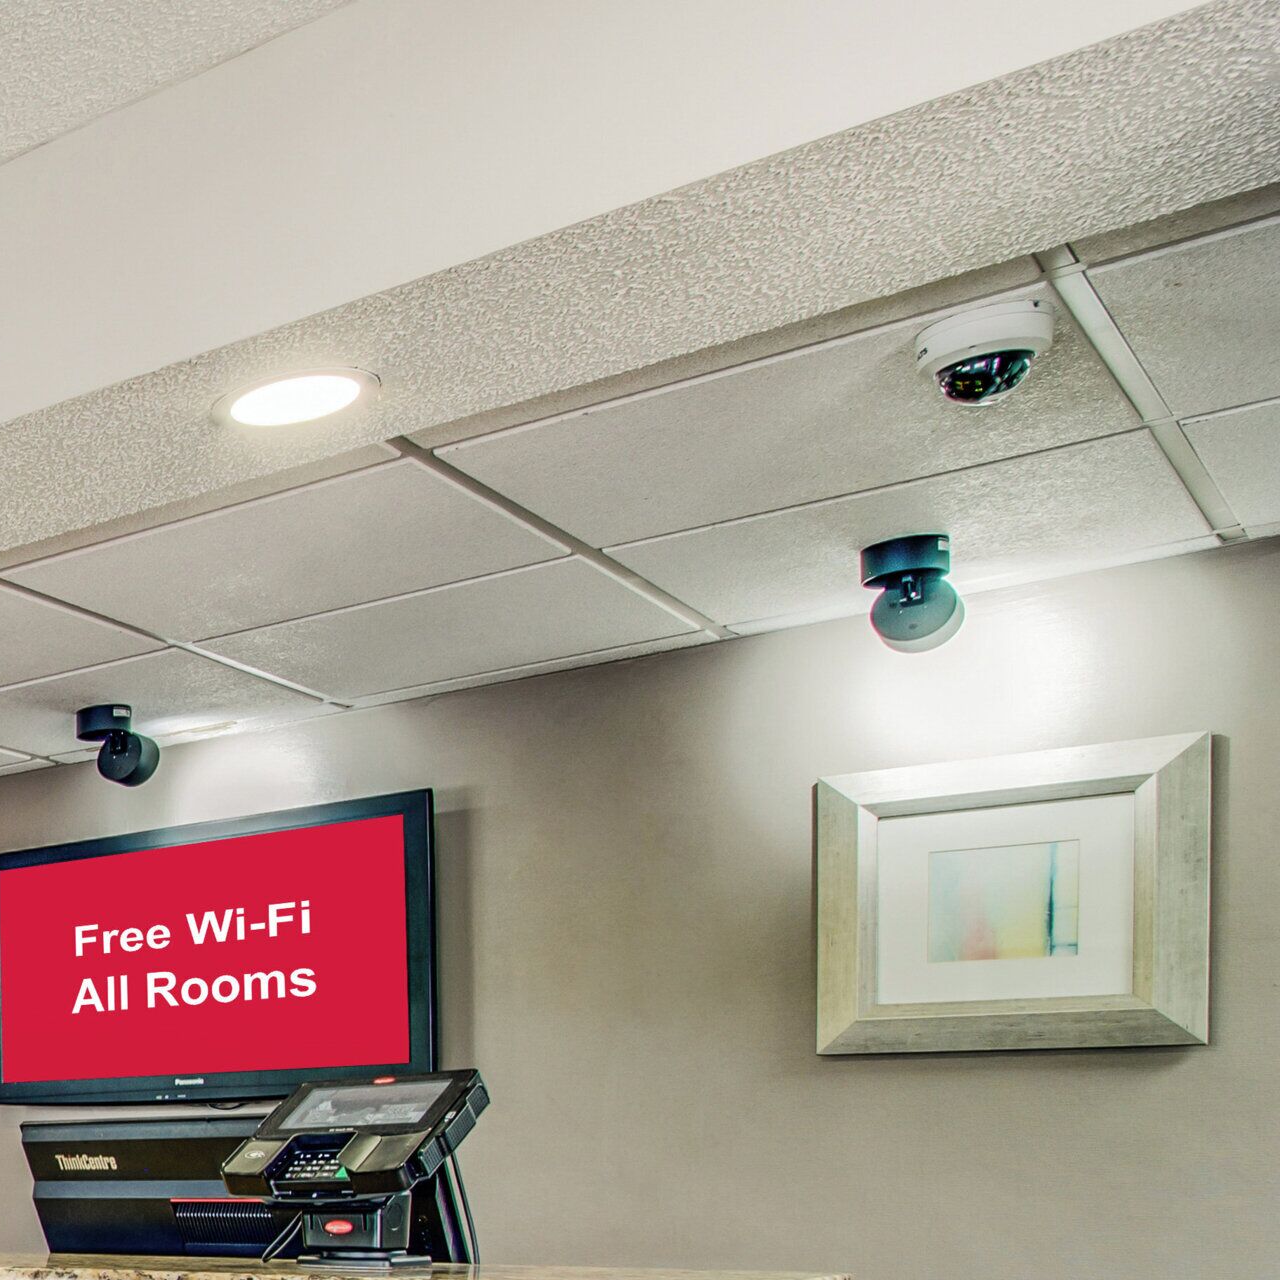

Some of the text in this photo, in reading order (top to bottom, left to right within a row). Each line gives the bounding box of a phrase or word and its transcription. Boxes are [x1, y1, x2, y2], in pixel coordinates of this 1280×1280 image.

[74, 900, 311, 957] Free Wi-Fi
[71, 967, 317, 1014] All Rooms
[55, 1154, 118, 1171] ThinkCentre
